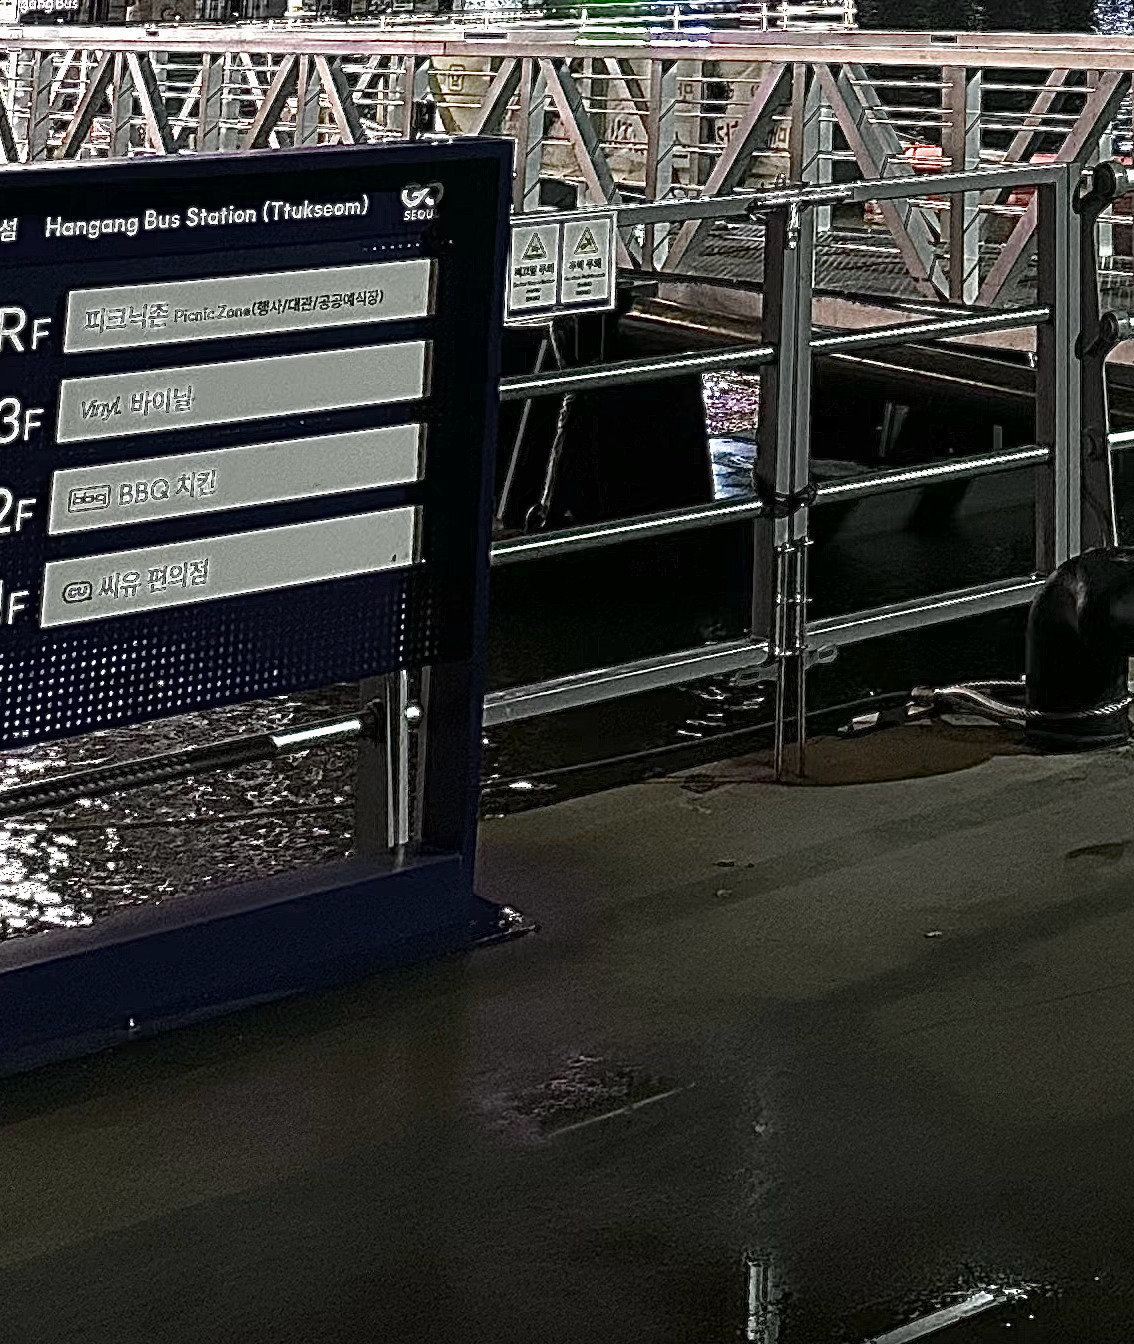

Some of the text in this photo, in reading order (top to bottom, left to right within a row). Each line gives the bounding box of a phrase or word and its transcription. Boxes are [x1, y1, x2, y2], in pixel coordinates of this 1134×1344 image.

[0, 194, 370, 241] 섬 Hangang Bus Station (Ttukseom)
[403, 208, 440, 221] SEOUL
[84, 302, 169, 333] 피크닉존
[173, 308, 215, 323] Picnic
[130, 385, 193, 417] 바이닐
[0, 397, 44, 444] 3F
[118, 478, 170, 506] BBQ
[175, 469, 216, 498] 치킨
[67, 558, 209, 599] CU 씨유 편의점
